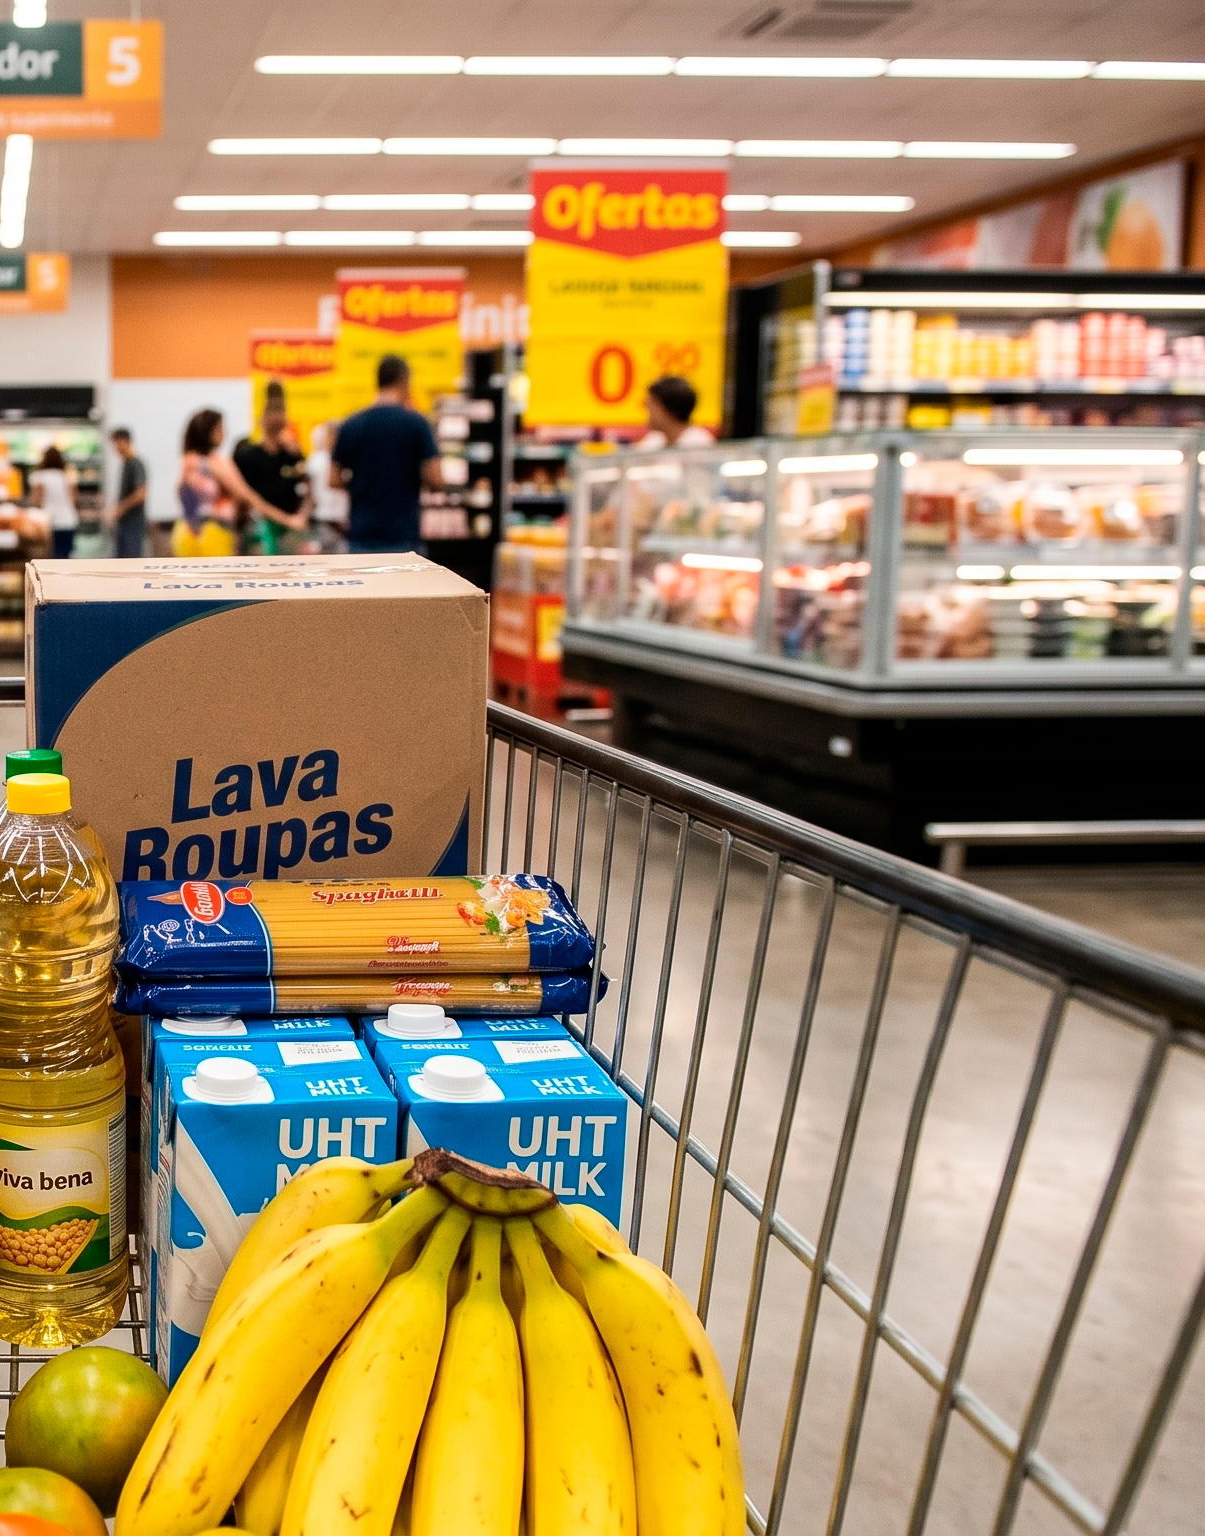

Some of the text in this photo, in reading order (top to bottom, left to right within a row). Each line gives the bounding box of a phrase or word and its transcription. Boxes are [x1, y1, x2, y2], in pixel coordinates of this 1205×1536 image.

[105, 35, 142, 86] 5
[543, 181, 719, 240] Ofertas
[143, 579, 364, 590] Lava Roupas
[171, 749, 340, 824] Lava
[122, 803, 395, 881] Roupas
[305, 1077, 363, 1090] UHT
[310, 1084, 373, 1097] MILK
[531, 1076, 589, 1089] UHT
[538, 1084, 603, 1096] MILK
[279, 1118, 387, 1159] UHT
[509, 1116, 618, 1157] UHT
[39, 1171, 94, 1191] bena
